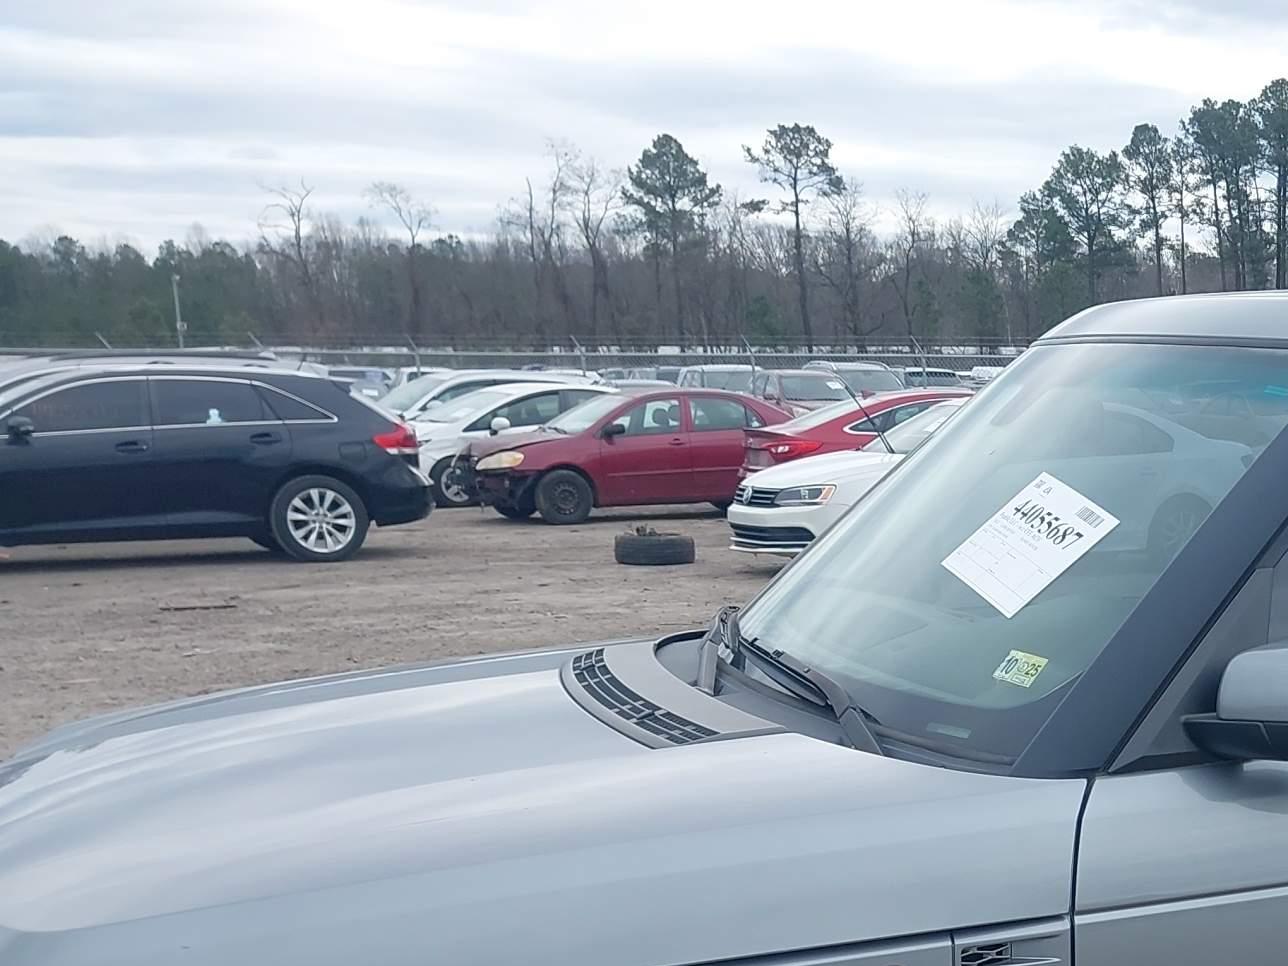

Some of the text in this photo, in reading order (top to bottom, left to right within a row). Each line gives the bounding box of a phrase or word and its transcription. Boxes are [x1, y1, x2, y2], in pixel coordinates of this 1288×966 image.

[1012, 499, 1084, 550] 44055687
[1000, 655, 1042, 677] 10 25
